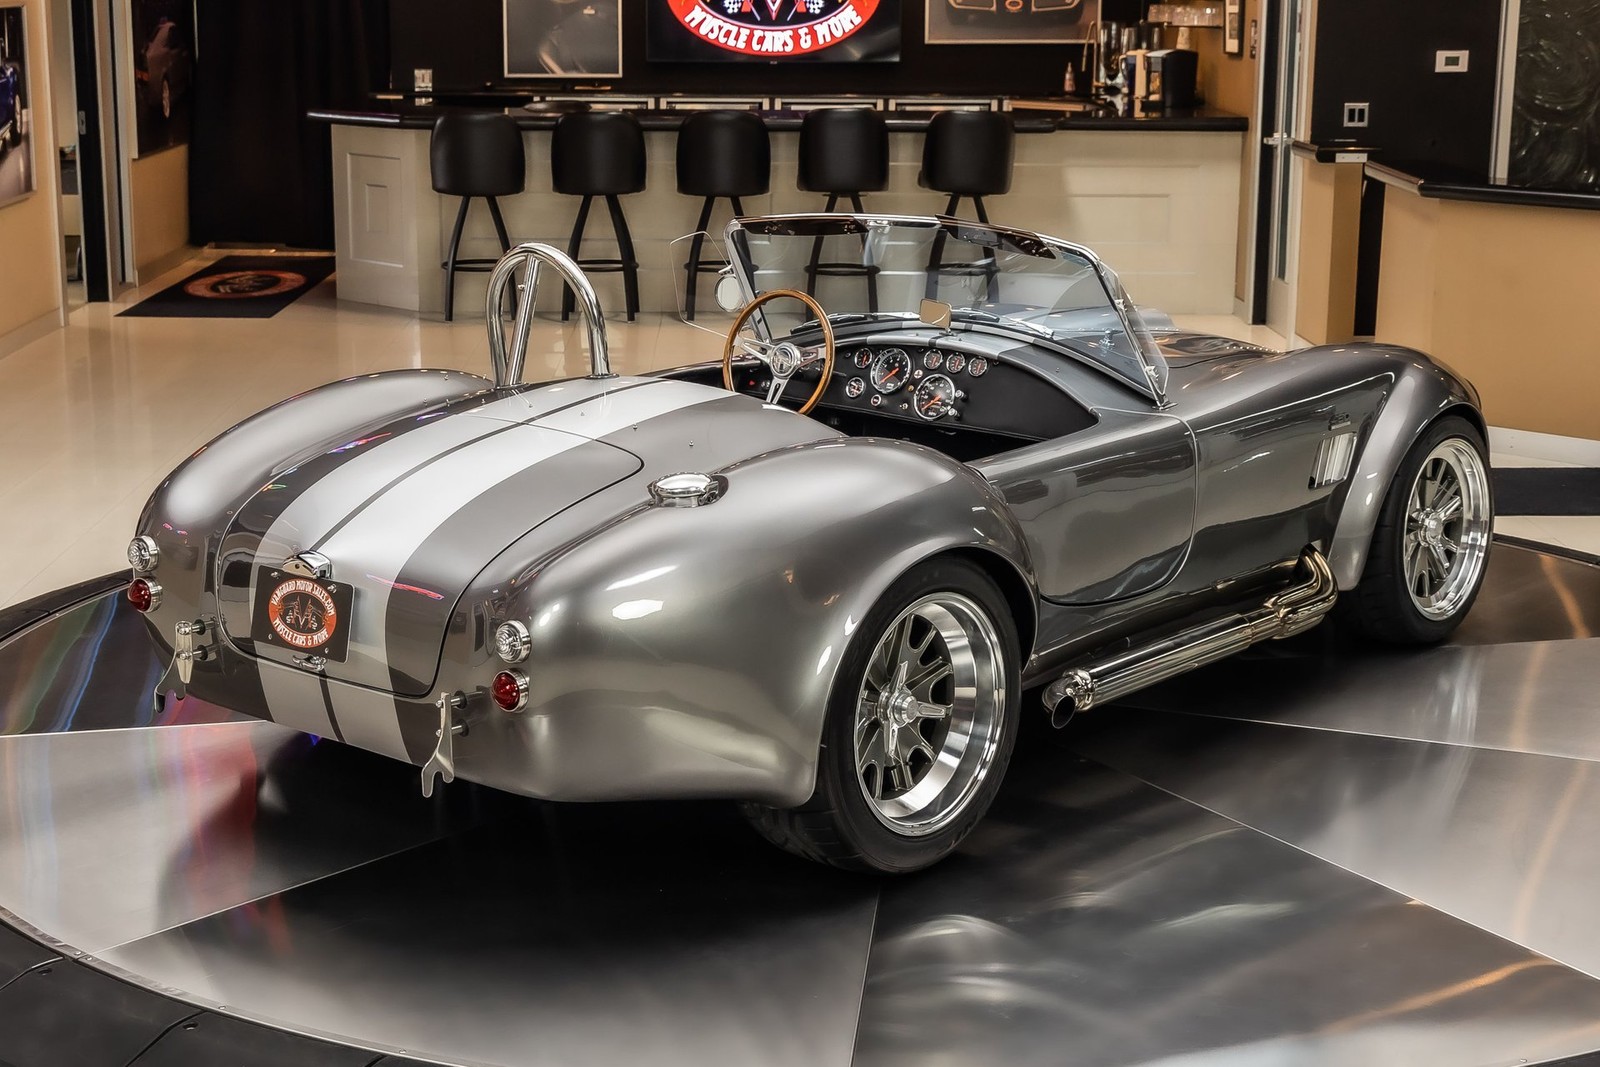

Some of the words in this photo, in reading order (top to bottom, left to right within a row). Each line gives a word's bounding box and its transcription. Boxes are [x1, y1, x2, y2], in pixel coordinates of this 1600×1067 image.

[684, 4, 751, 50] MUSCLE
[752, 30, 794, 53] CARS
[798, 28, 812, 49] &
[814, 4, 862, 45] MORE
[271, 580, 296, 605] VANGUARD
[296, 580, 313, 592] MOTOR
[273, 616, 293, 641] MUSCLE
[293, 634, 306, 646] CARS
[307, 635, 313, 646] &
[313, 628, 328, 645] MORE
